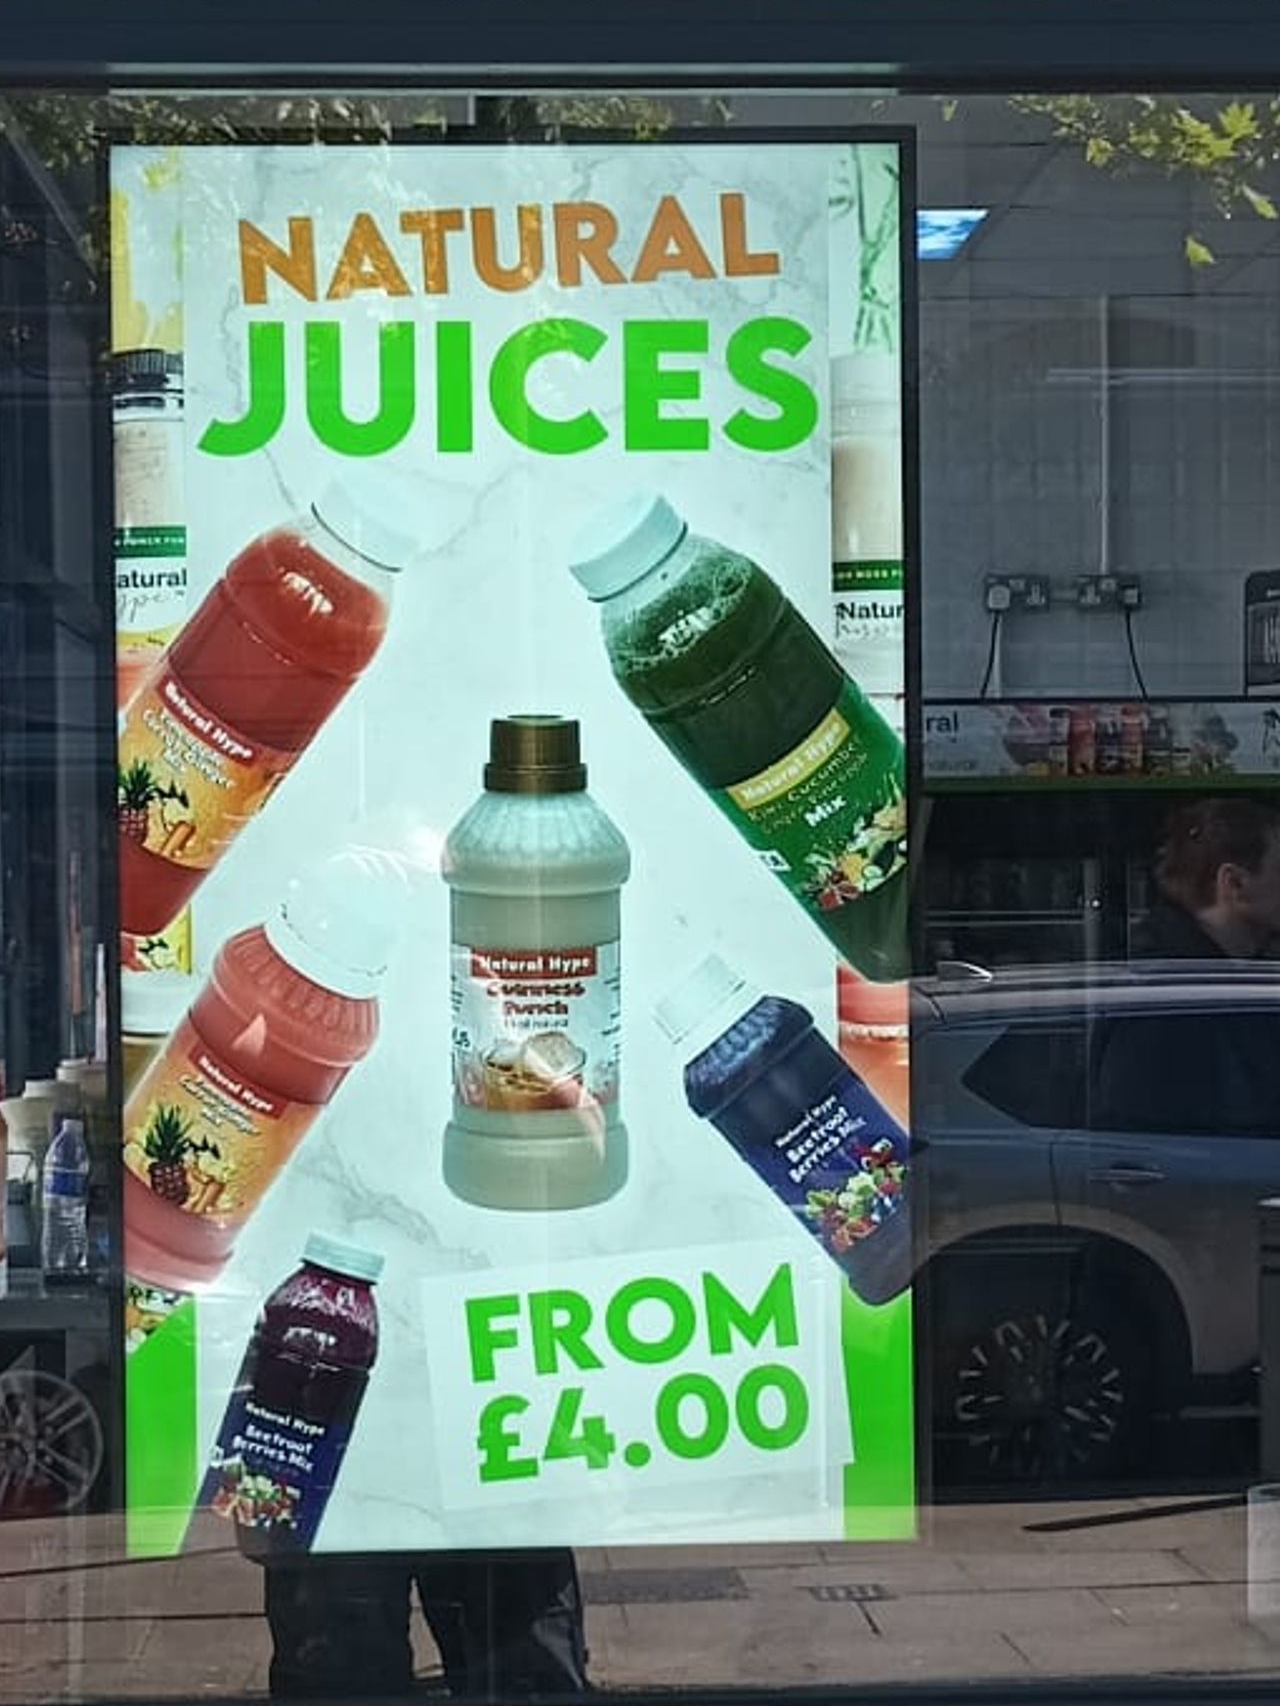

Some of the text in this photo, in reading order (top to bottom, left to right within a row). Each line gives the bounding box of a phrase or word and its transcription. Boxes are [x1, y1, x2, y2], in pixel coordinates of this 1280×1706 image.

[236, 192, 781, 307] NATURAL
[195, 316, 820, 460] JUICES
[116, 566, 187, 590] atural
[837, 601, 904, 621] Natur
[804, 795, 847, 827] Mix
[464, 1262, 800, 1383] FROM
[476, 1362, 810, 1484] £4.00
